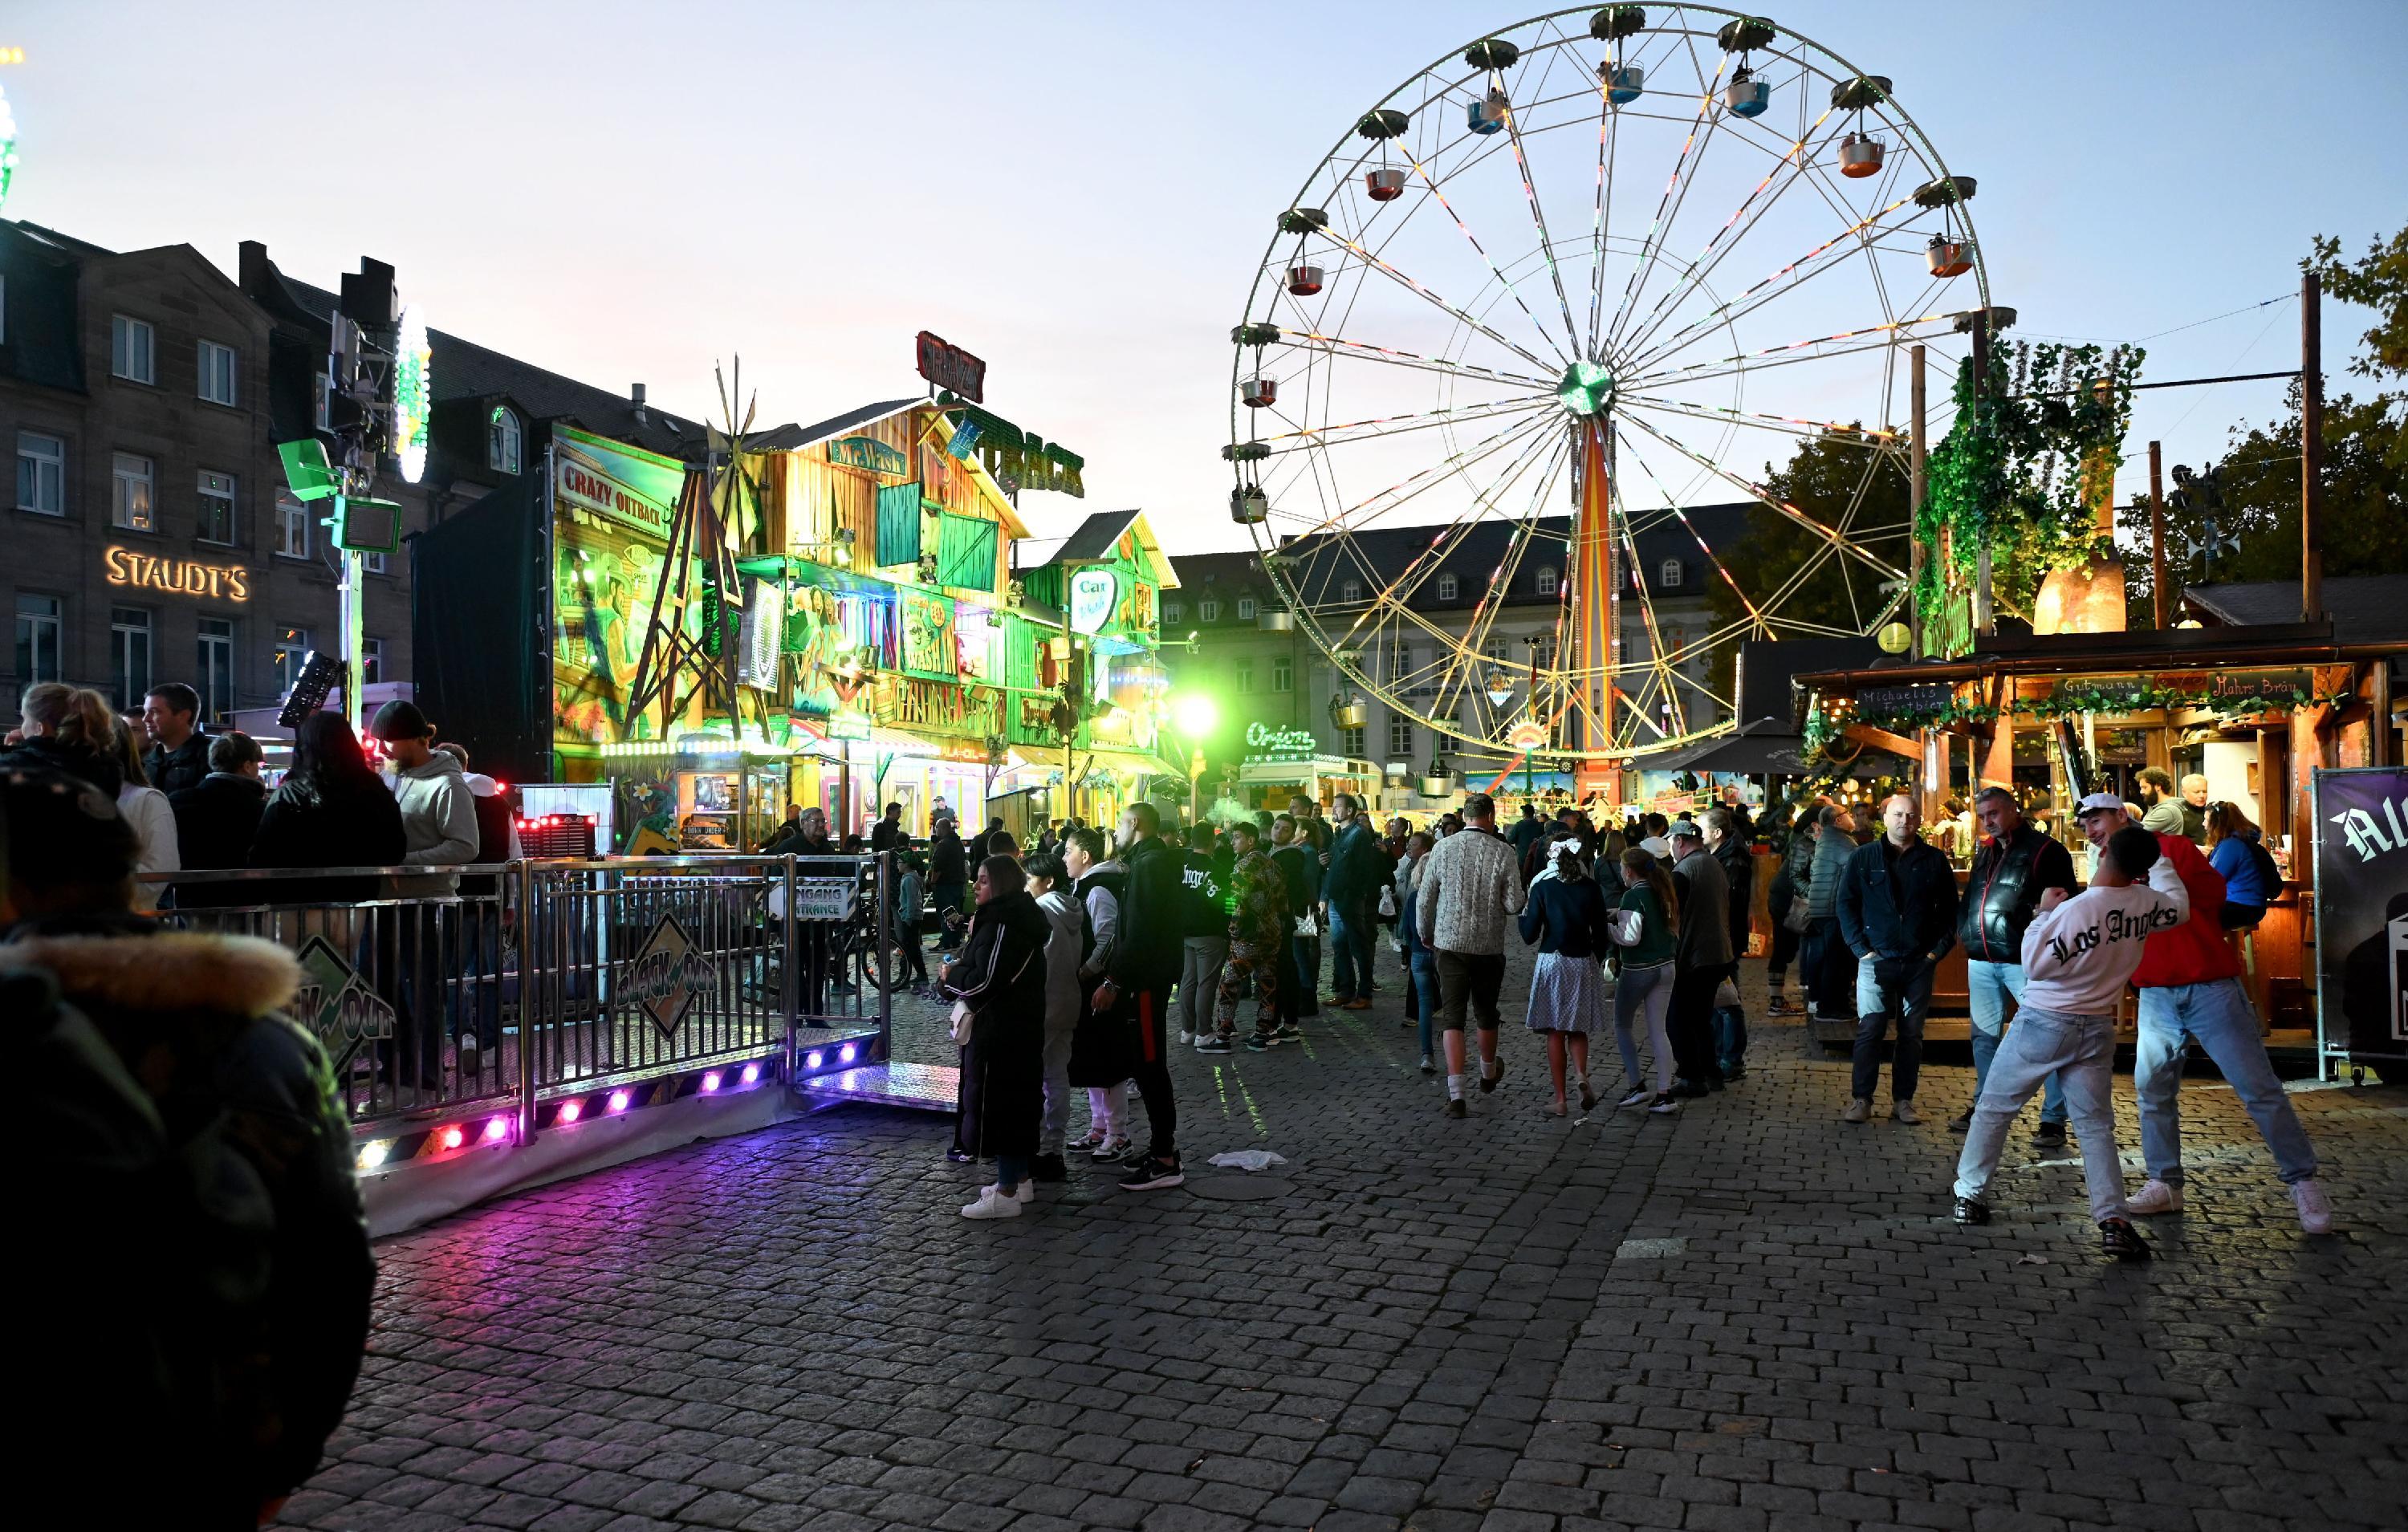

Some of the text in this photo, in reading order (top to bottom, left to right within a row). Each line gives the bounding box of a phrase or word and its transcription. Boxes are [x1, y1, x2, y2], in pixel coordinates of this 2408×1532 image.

[565, 465, 660, 527] CRAZY OUTBACK
[110, 549, 250, 599] STAUDT'S
[1080, 580, 1106, 593] Car
[1865, 689, 1936, 702] Michaelis
[2064, 680, 2136, 693] Gutmann
[1247, 721, 1316, 751] Orion
[795, 888, 841, 900] NGANG
[795, 904, 840, 915] TRANCE
[2046, 921, 2100, 967] Los
[616, 950, 717, 1009] BLACK OUT
[341, 985, 397, 1041] OUT
